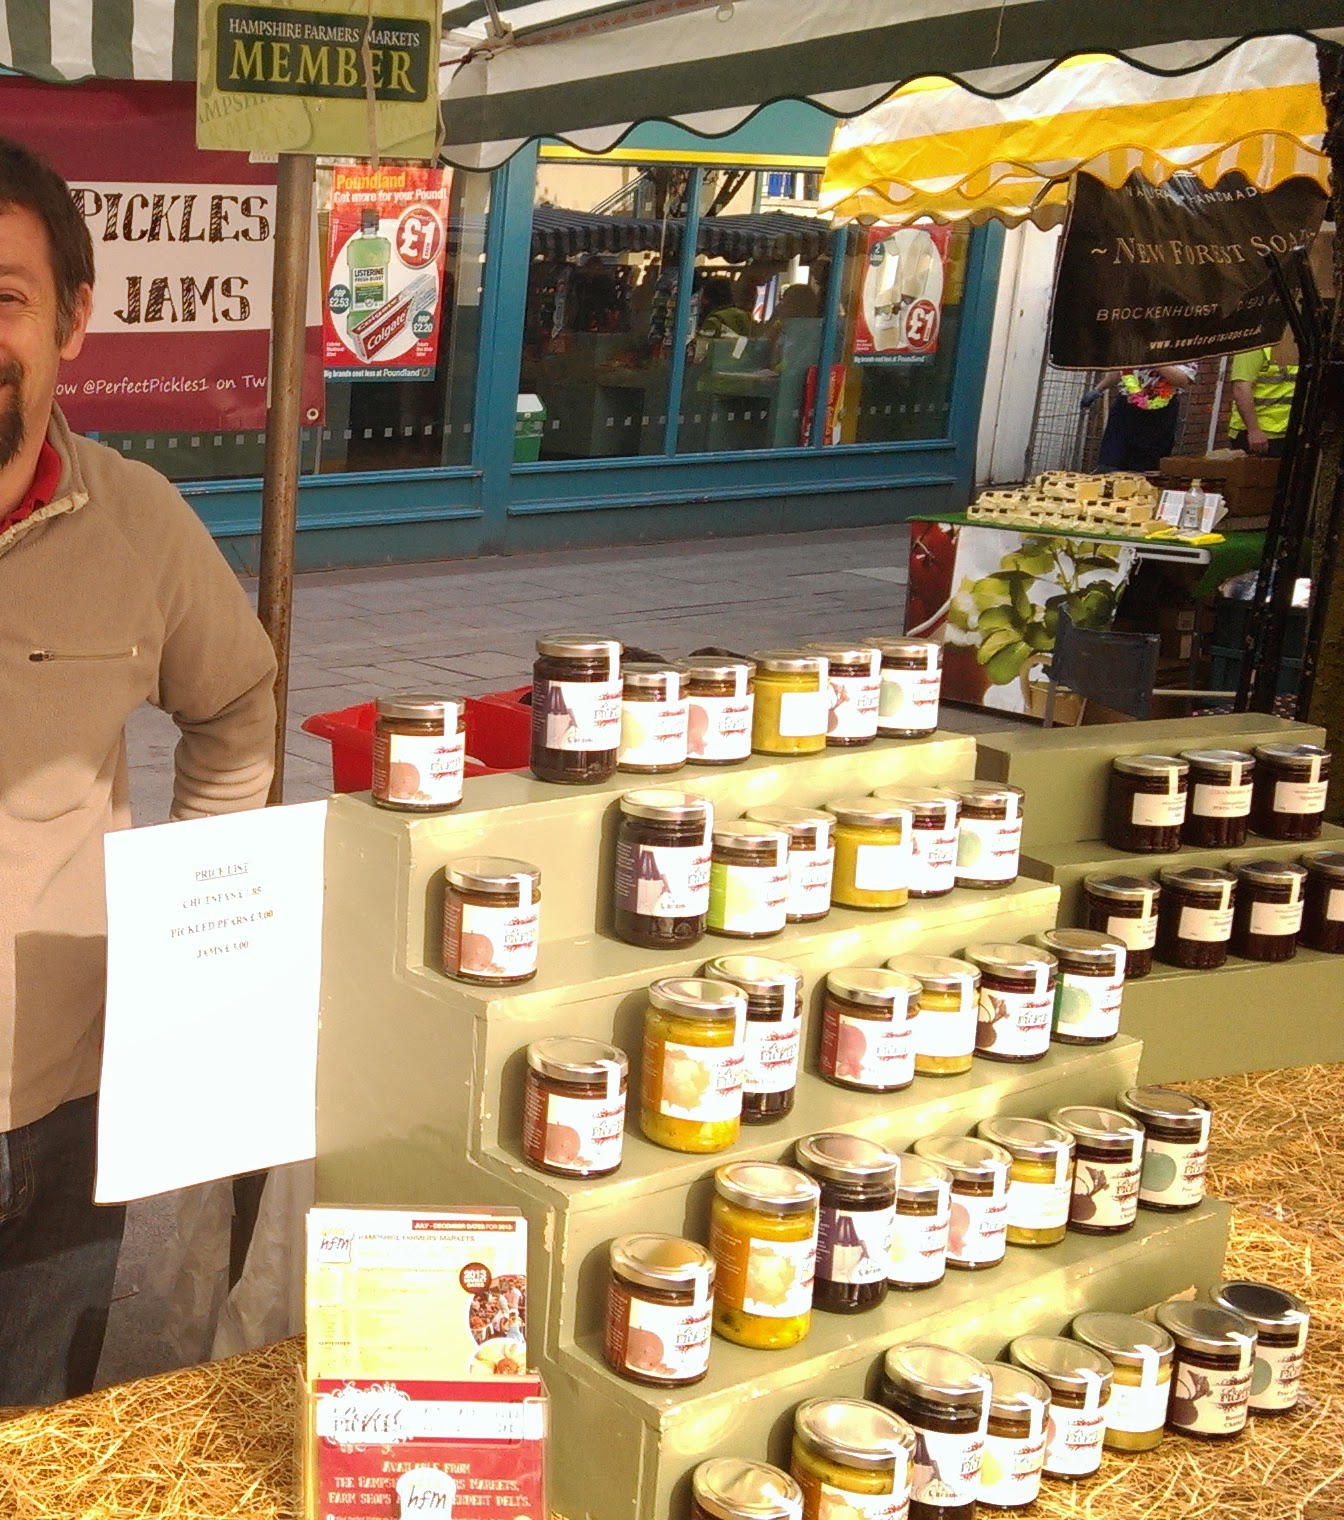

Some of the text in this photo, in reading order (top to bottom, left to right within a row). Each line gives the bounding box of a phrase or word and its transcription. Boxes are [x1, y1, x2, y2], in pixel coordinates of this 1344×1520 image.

[229, 17, 302, 39] HAMPSHIRE
[366, 28, 420, 47] MARKETS
[228, 38, 416, 94] MEMBER
[337, 172, 406, 190] Poundland
[334, 188, 447, 204] Get more for your Pound!
[399, 217, 436, 260] £1
[354, 267, 384, 278] LISTERINE
[113, 275, 251, 325] JAMS
[329, 297, 350, 308] £2.53
[1096, 303, 1218, 322] BROCKENHURST
[367, 312, 406, 350] Colgate
[413, 323, 433, 333] £2.20
[908, 307, 935, 342] £1
[332, 369, 352, 378] brands
[365, 369, 376, 377] less
[383, 369, 420, 377] Poundland
[83, 376, 208, 395] @PerfectPickles1
[216, 379, 237, 391] on
[195, 862, 248, 881] PRICE LIST
[171, 921, 215, 938] PICKLED
[217, 915, 248, 929] PEARS
[196, 946, 223, 959] JAMS
[414, 1222, 429, 1230] JULY
[434, 1222, 466, 1230] DECEMBER
[485, 1223, 497, 1231] FOR
[463, 1269, 487, 1280] 2013
[443, 1463, 471, 1474] FROM
[334, 1477, 355, 1489] THE
[469, 1479, 520, 1492] MARKETS,
[328, 1491, 356, 1505] FARM
[360, 1492, 392, 1505] SHOPS
[406, 1484, 447, 1510] hfm
